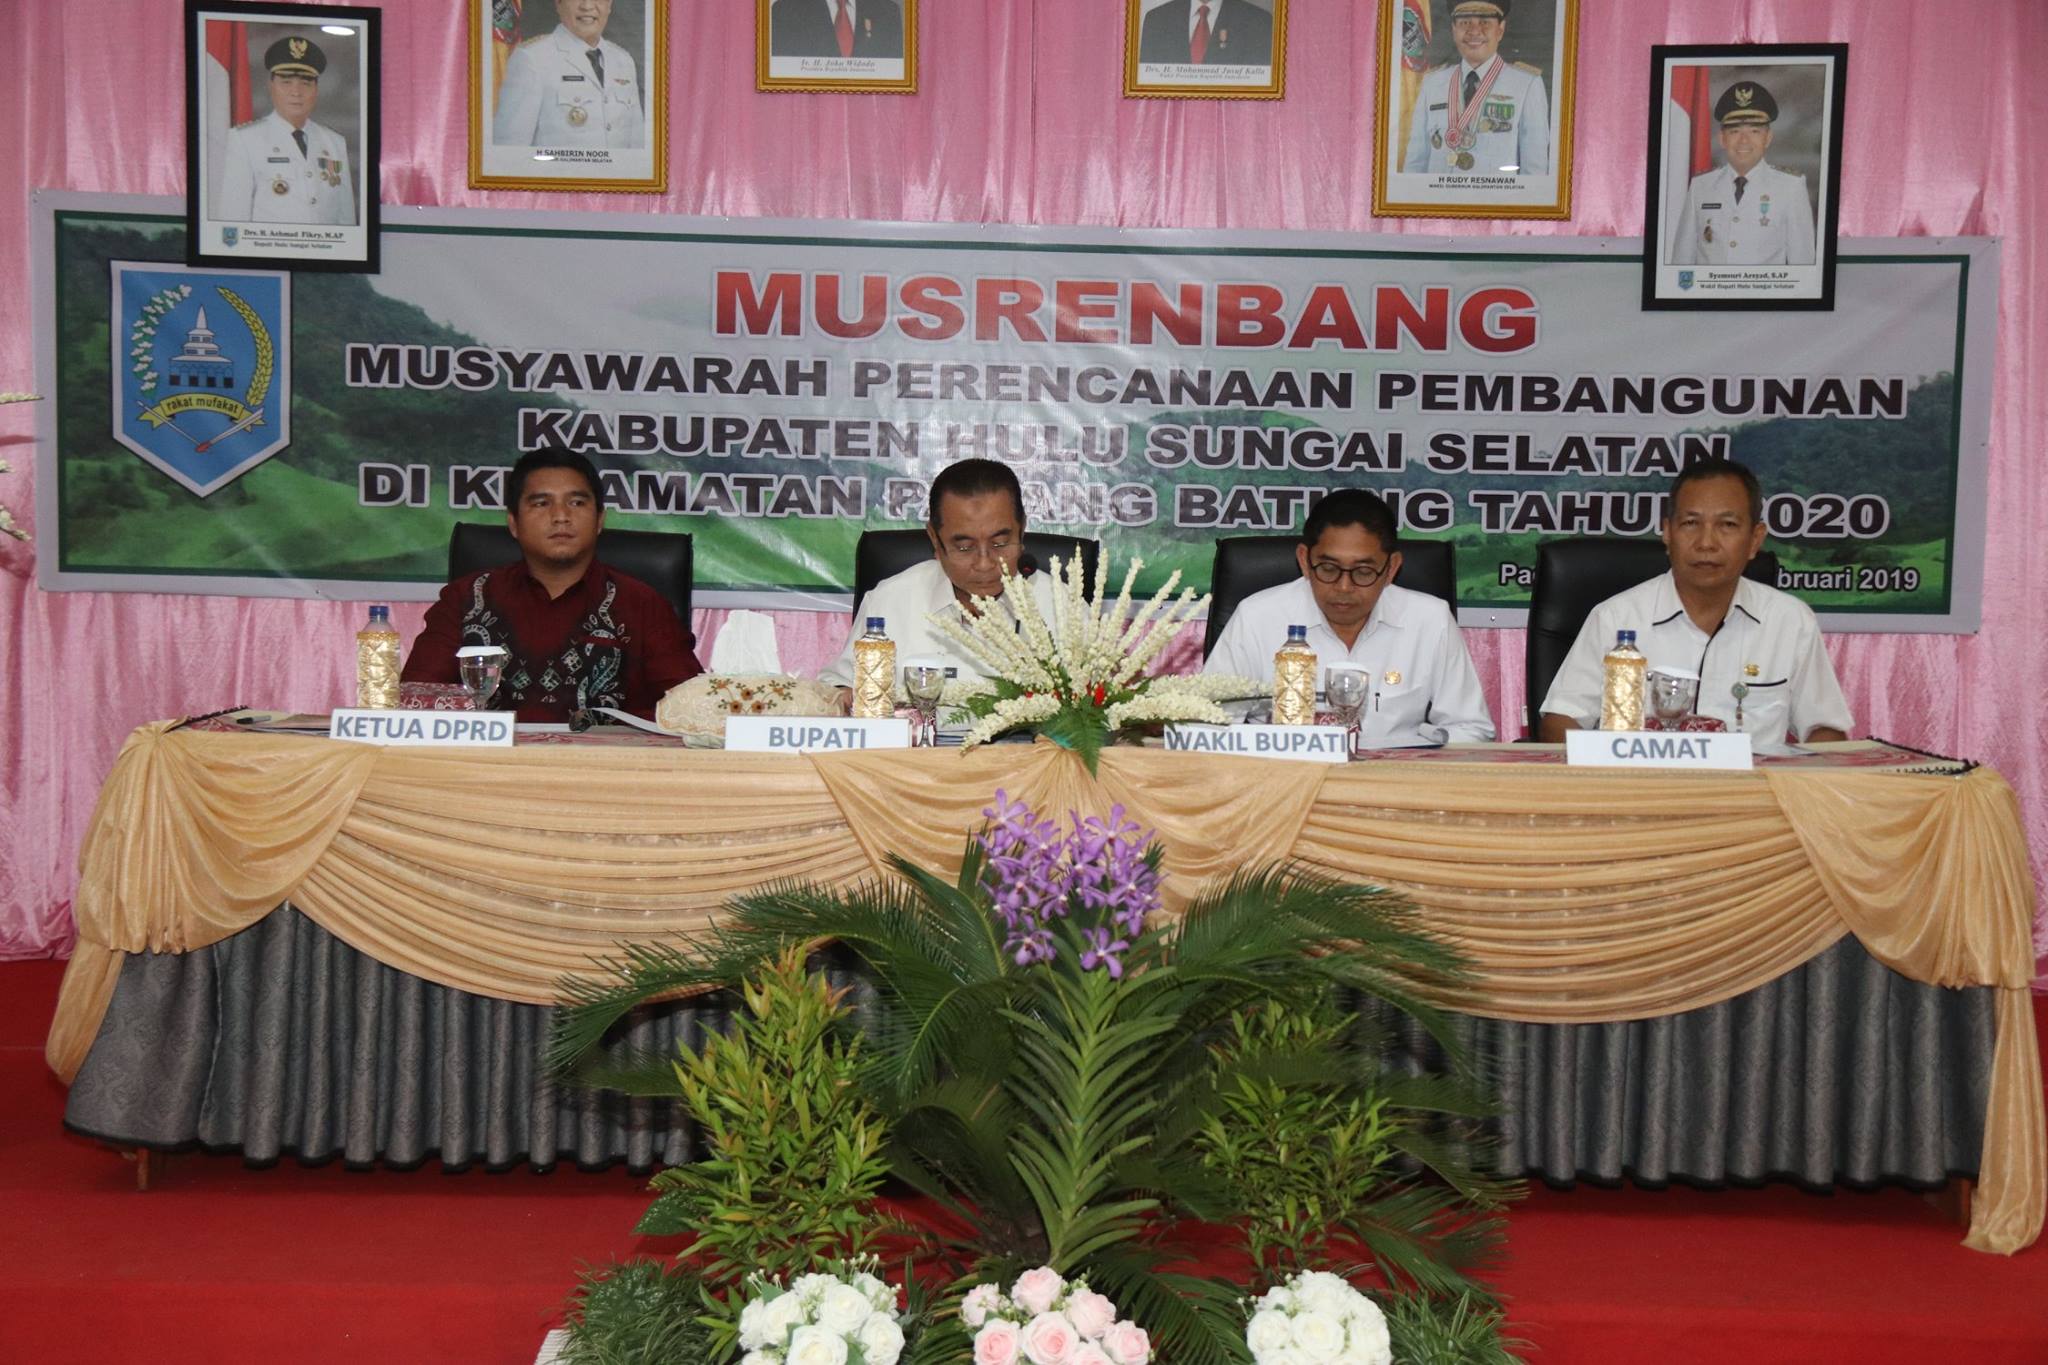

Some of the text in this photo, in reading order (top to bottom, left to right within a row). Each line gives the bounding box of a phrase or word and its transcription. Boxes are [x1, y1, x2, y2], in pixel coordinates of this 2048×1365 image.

[544, 149, 584, 157] SAHBIRIN
[586, 150, 609, 158] NOOR
[713, 270, 1539, 353] MUSRENBANG
[348, 345, 1905, 416] MUSYAWARAH PERENCANAAN PEMBANGUNAN
[166, 397, 239, 413] rakat mufakat
[521, 411, 1731, 474] KABUPATEN HULU SUNGAI SELATAN
[362, 465, 1888, 536] DI KAMATAN PANG BATG TAHU 020
[1777, 568, 1919, 590] bruari 2019
[336, 716, 508, 742] KETUA DPRD
[768, 726, 867, 749] BUPATI
[1165, 731, 1347, 753] WAKIL BUPATI
[1611, 737, 1712, 760] CAMAT
